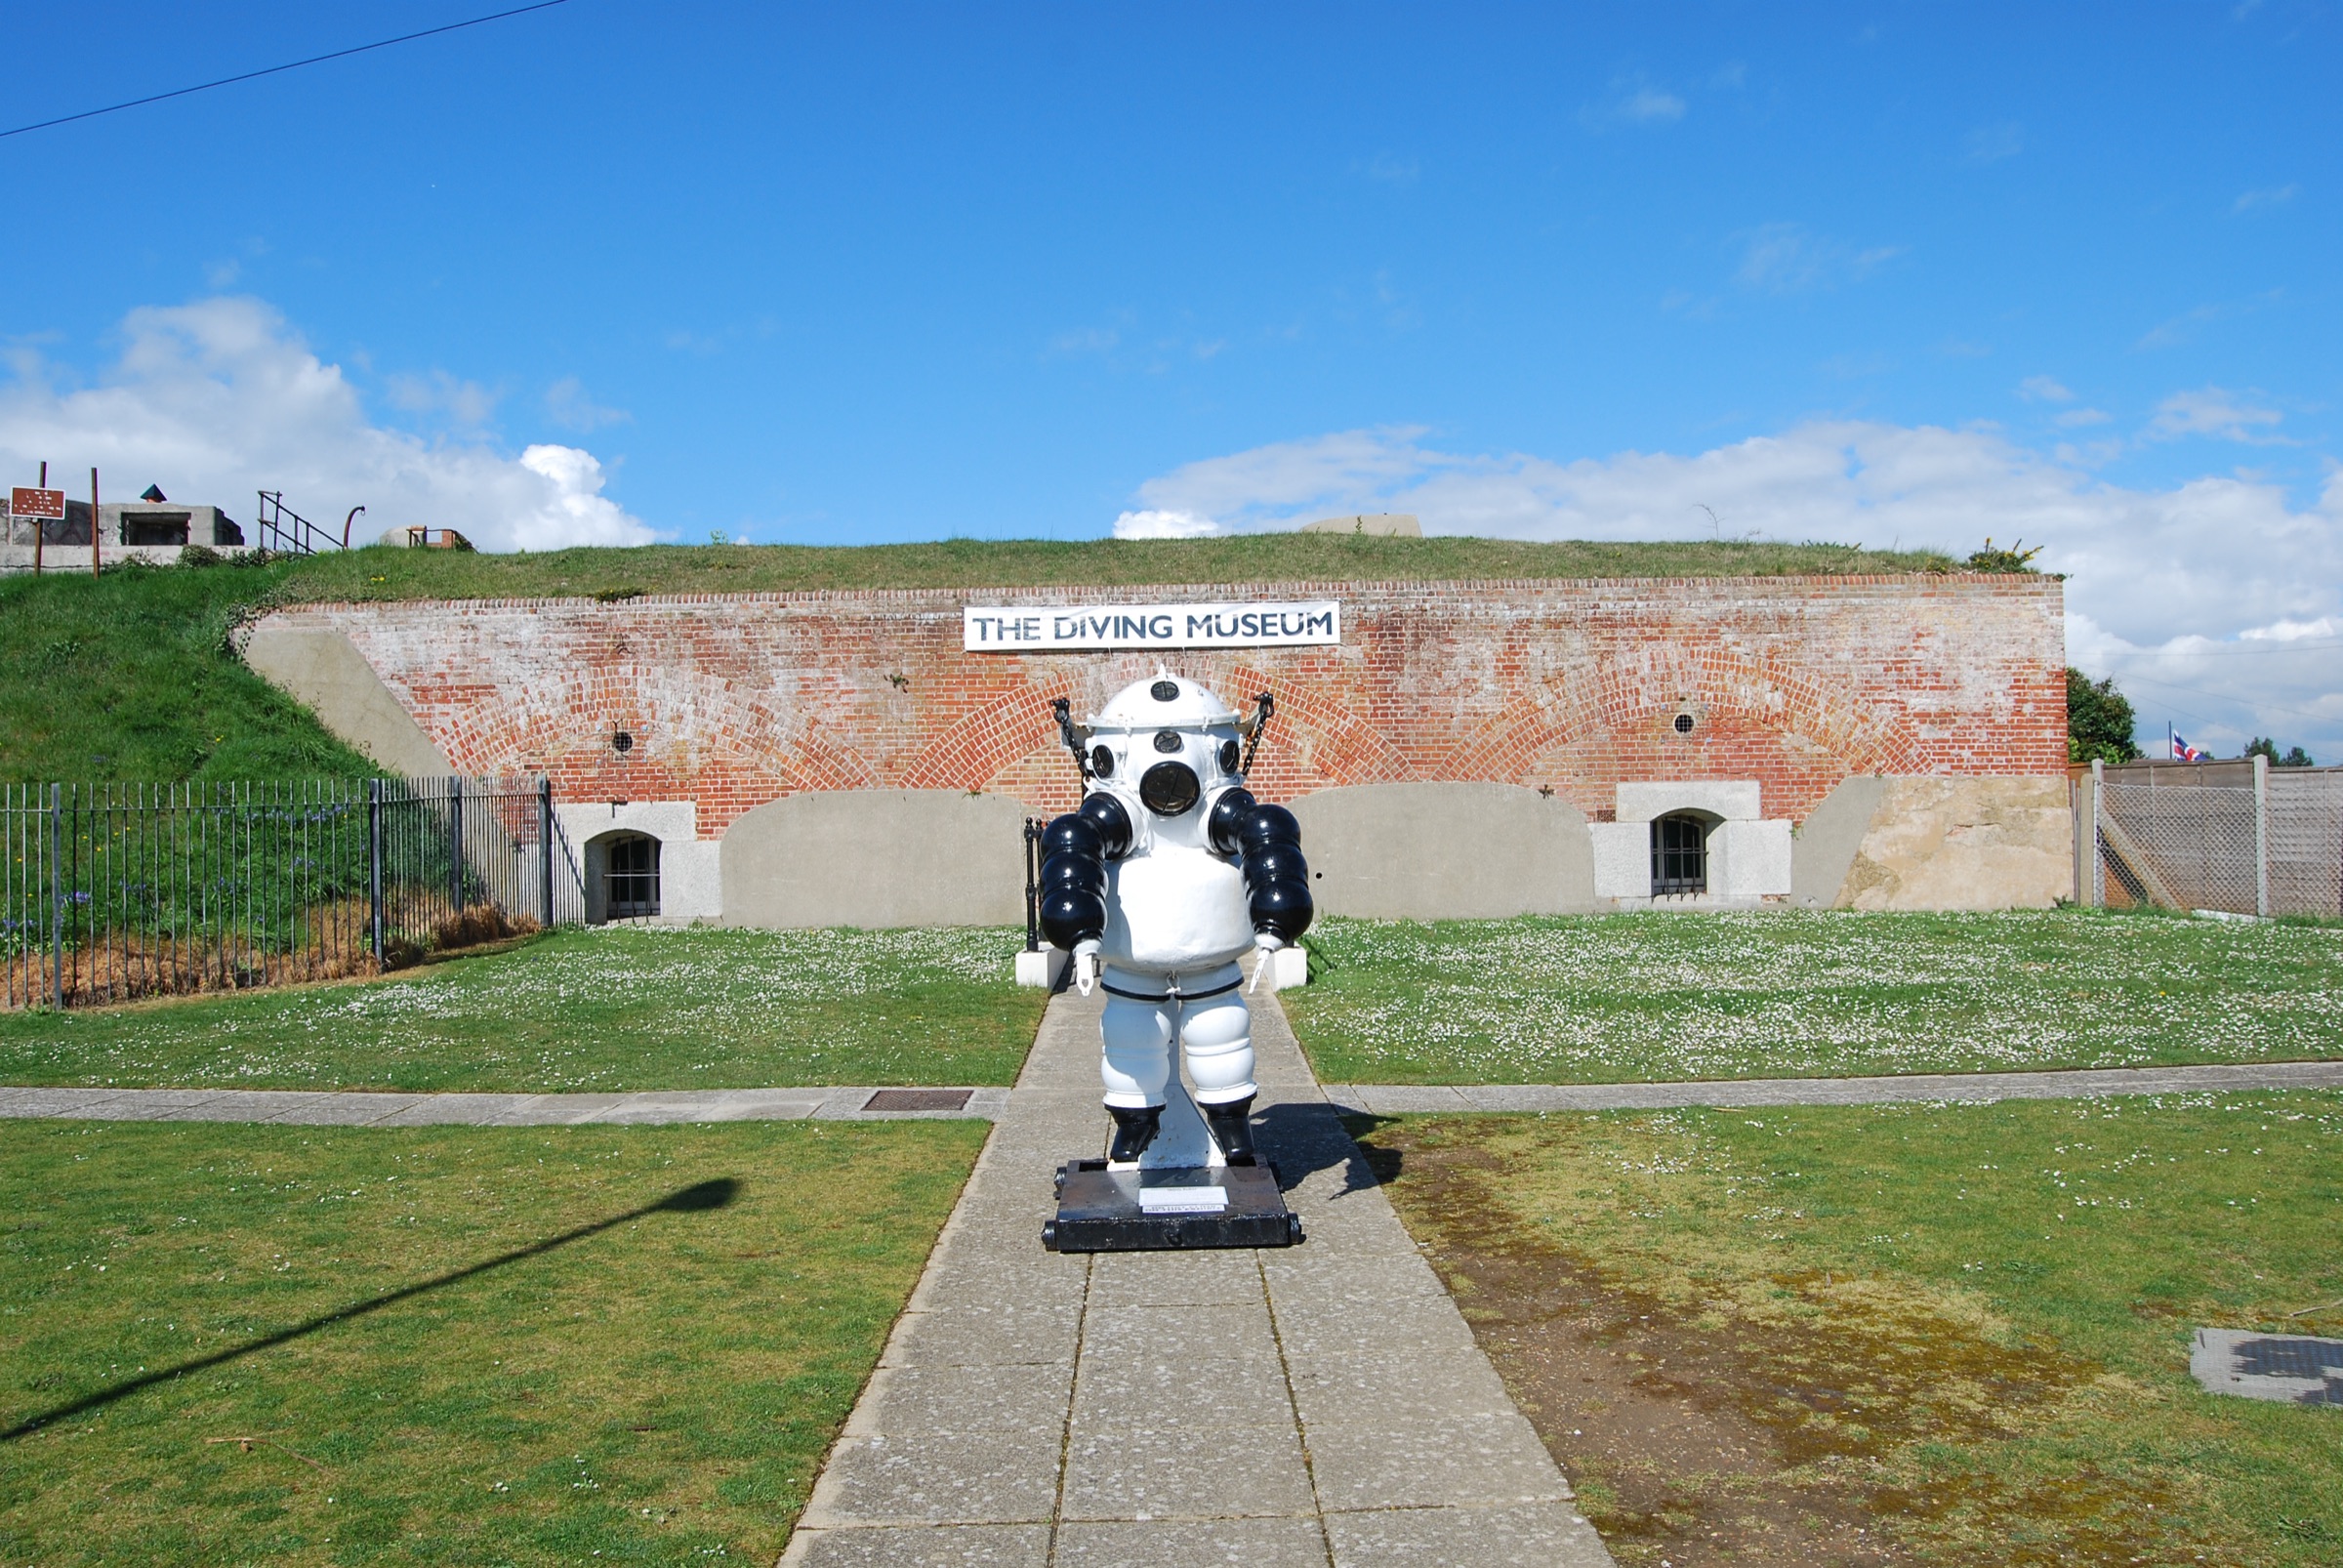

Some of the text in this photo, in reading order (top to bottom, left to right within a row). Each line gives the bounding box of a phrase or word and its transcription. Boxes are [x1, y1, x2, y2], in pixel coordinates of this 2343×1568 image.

[972, 611, 1333, 641] THE DIVING MUSEUM
